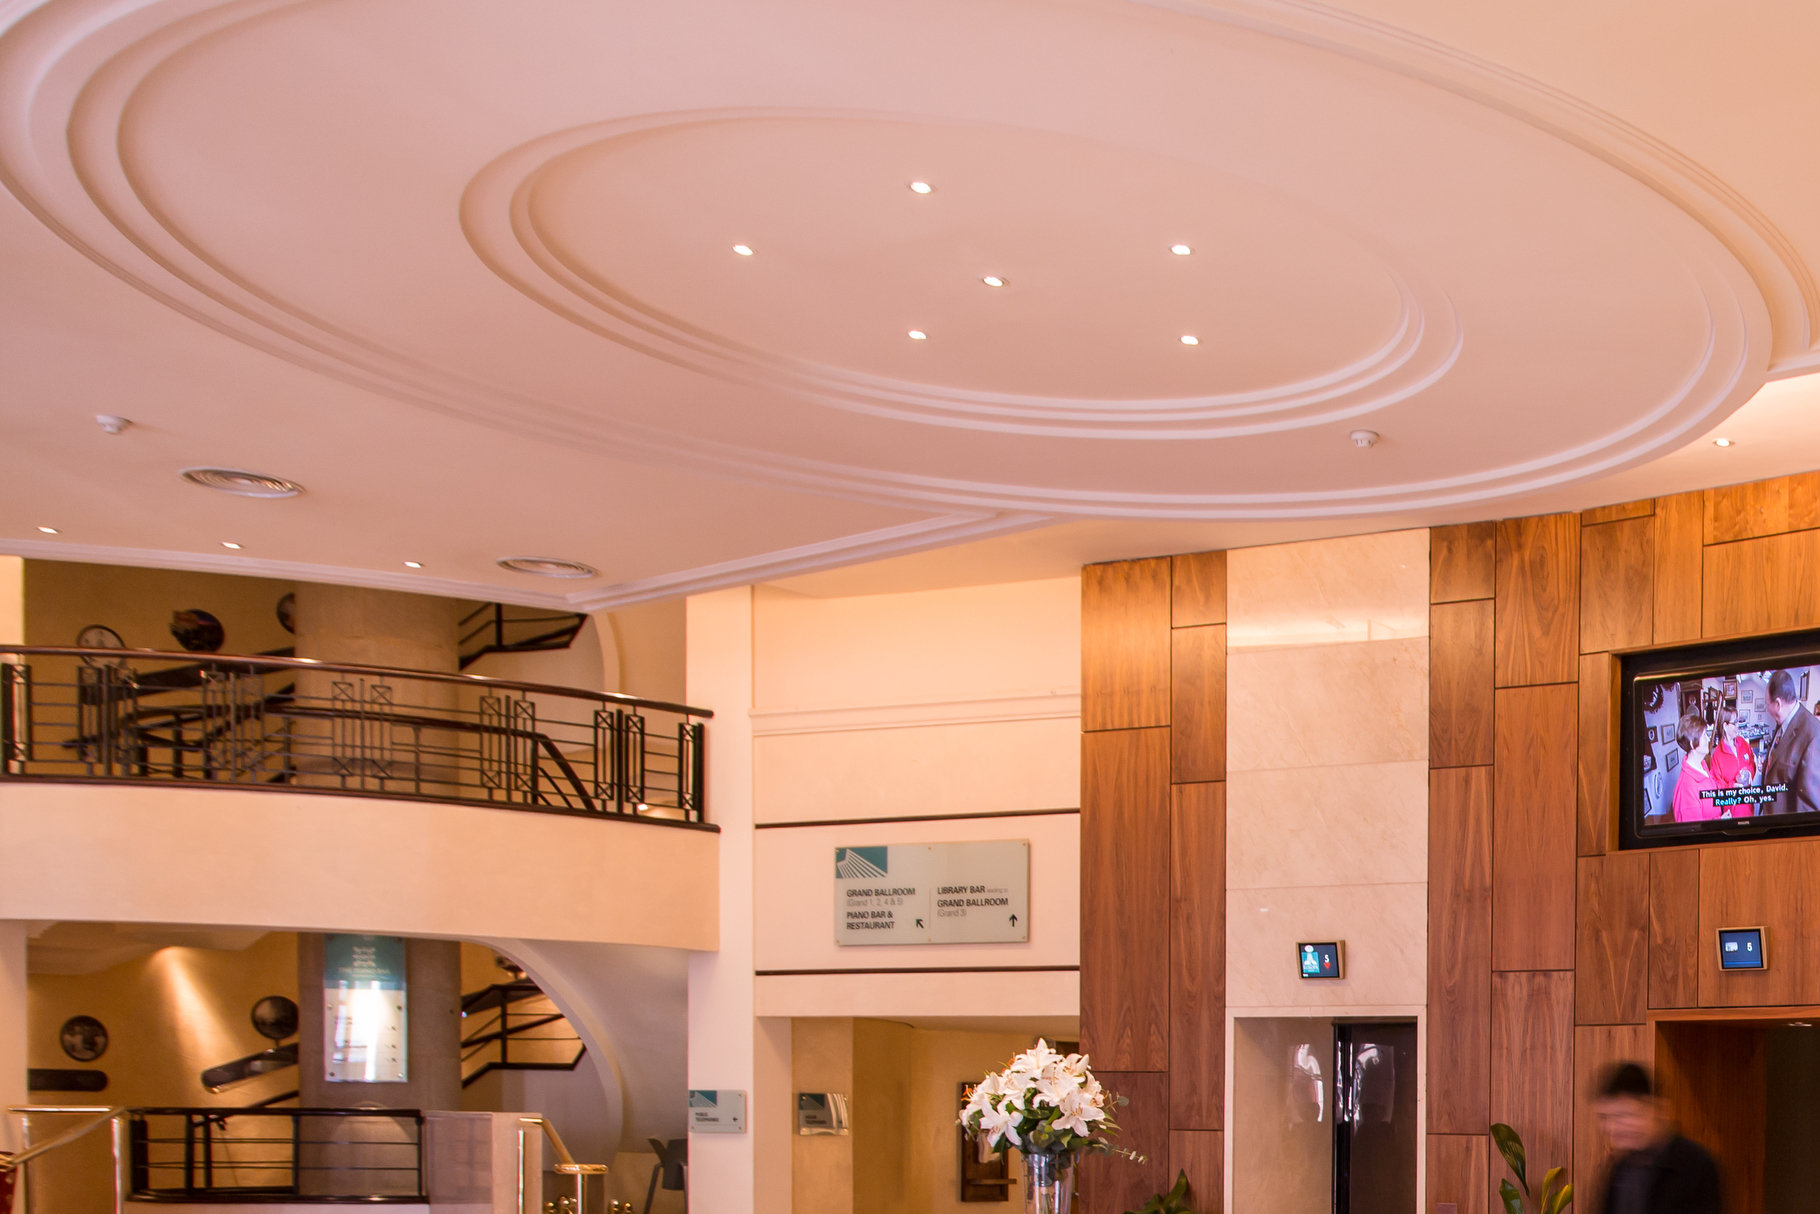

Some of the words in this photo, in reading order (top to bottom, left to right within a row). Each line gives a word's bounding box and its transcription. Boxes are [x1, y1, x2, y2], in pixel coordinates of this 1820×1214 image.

[1701, 790, 1716, 798] This
[1718, 789, 1724, 797] is
[1725, 789, 1737, 797] my
[1738, 787, 1764, 795] choice,
[1765, 784, 1789, 793] David.
[1715, 797, 1742, 806] Really?
[1743, 795, 1757, 804] Oh,
[1758, 795, 1774, 804] yes.
[847, 889, 873, 897] GRAND
[874, 888, 916, 896] BALLROOM
[937, 886, 968, 895] LIBRARY
[969, 885, 986, 894] BAR
[937, 899, 965, 908] GRAND
[966, 898, 1009, 907] BALLROOM
[847, 911, 870, 919] PIANO
[847, 921, 895, 930] RESTAURANT
[1747, 942, 1753, 952] 5
